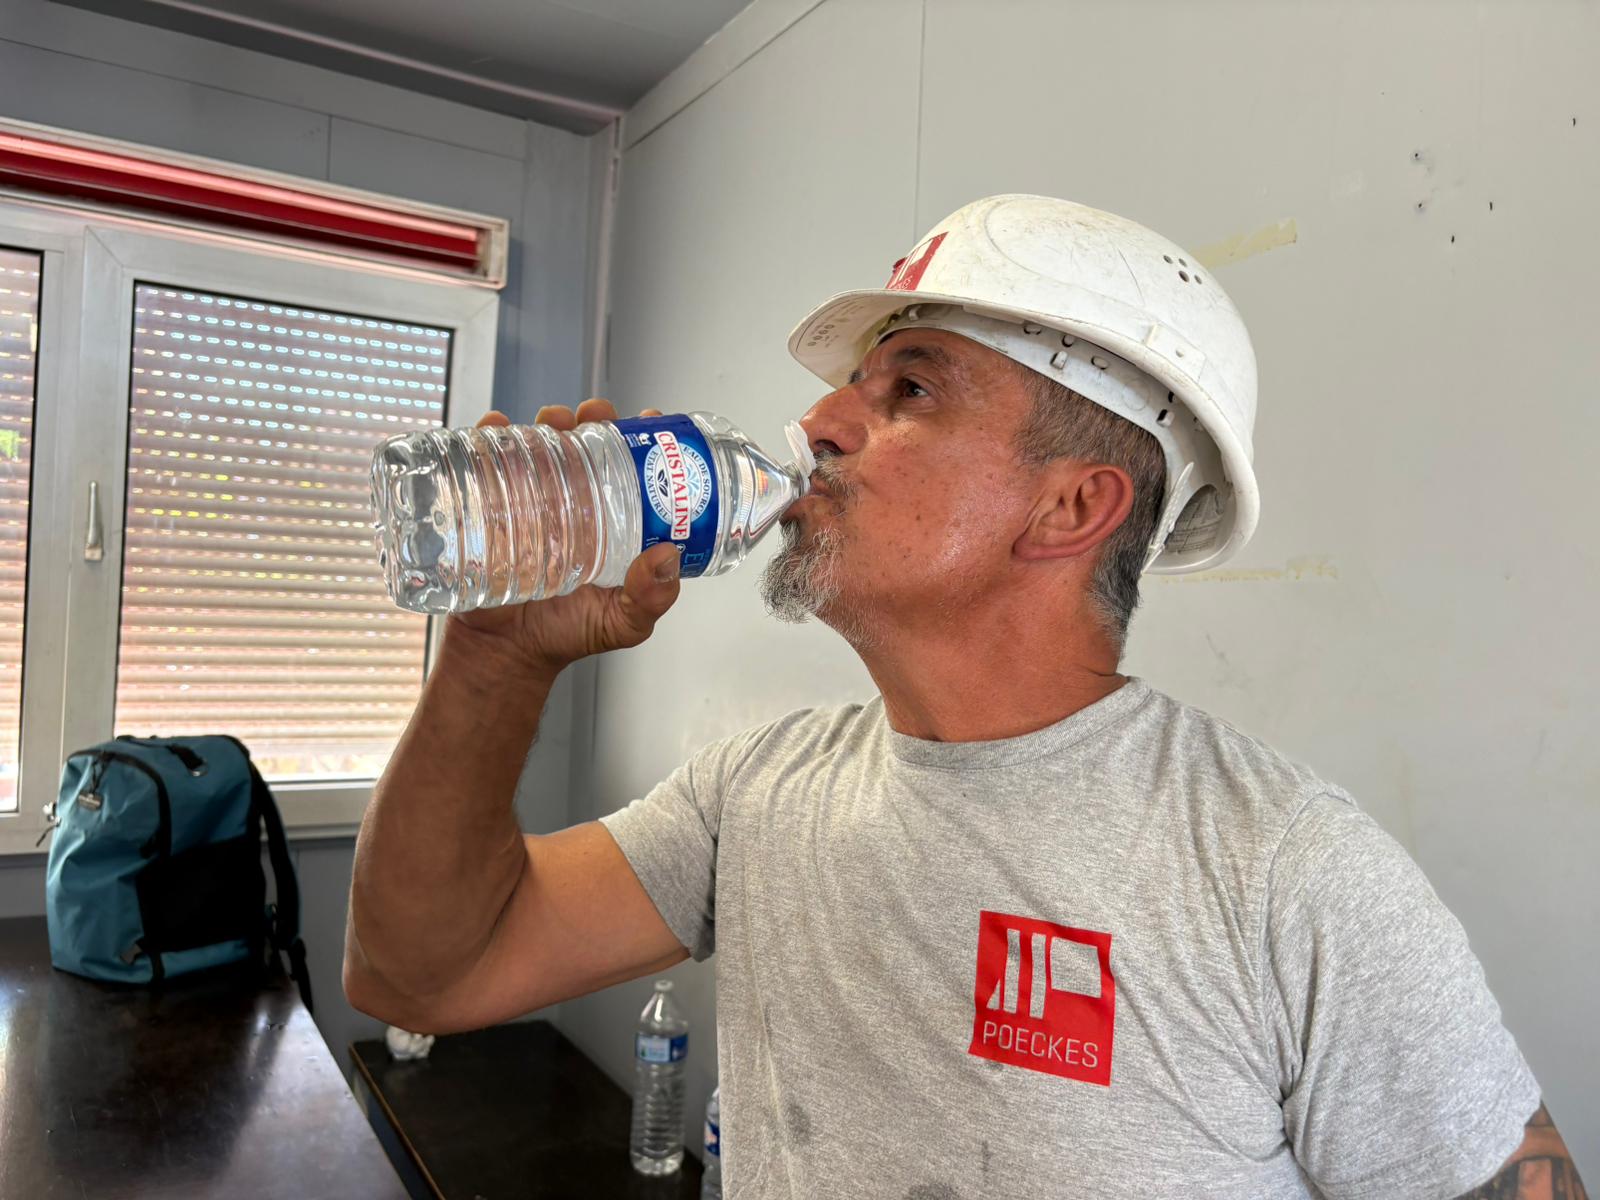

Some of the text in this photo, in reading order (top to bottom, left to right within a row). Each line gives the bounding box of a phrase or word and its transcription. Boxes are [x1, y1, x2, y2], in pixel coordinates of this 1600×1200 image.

[646, 475, 671, 520] NATUREL
[658, 433, 689, 537] CRISTALINE
[683, 446, 711, 517] EAU DE SOURCE
[983, 1021, 1099, 1068] POECKES
